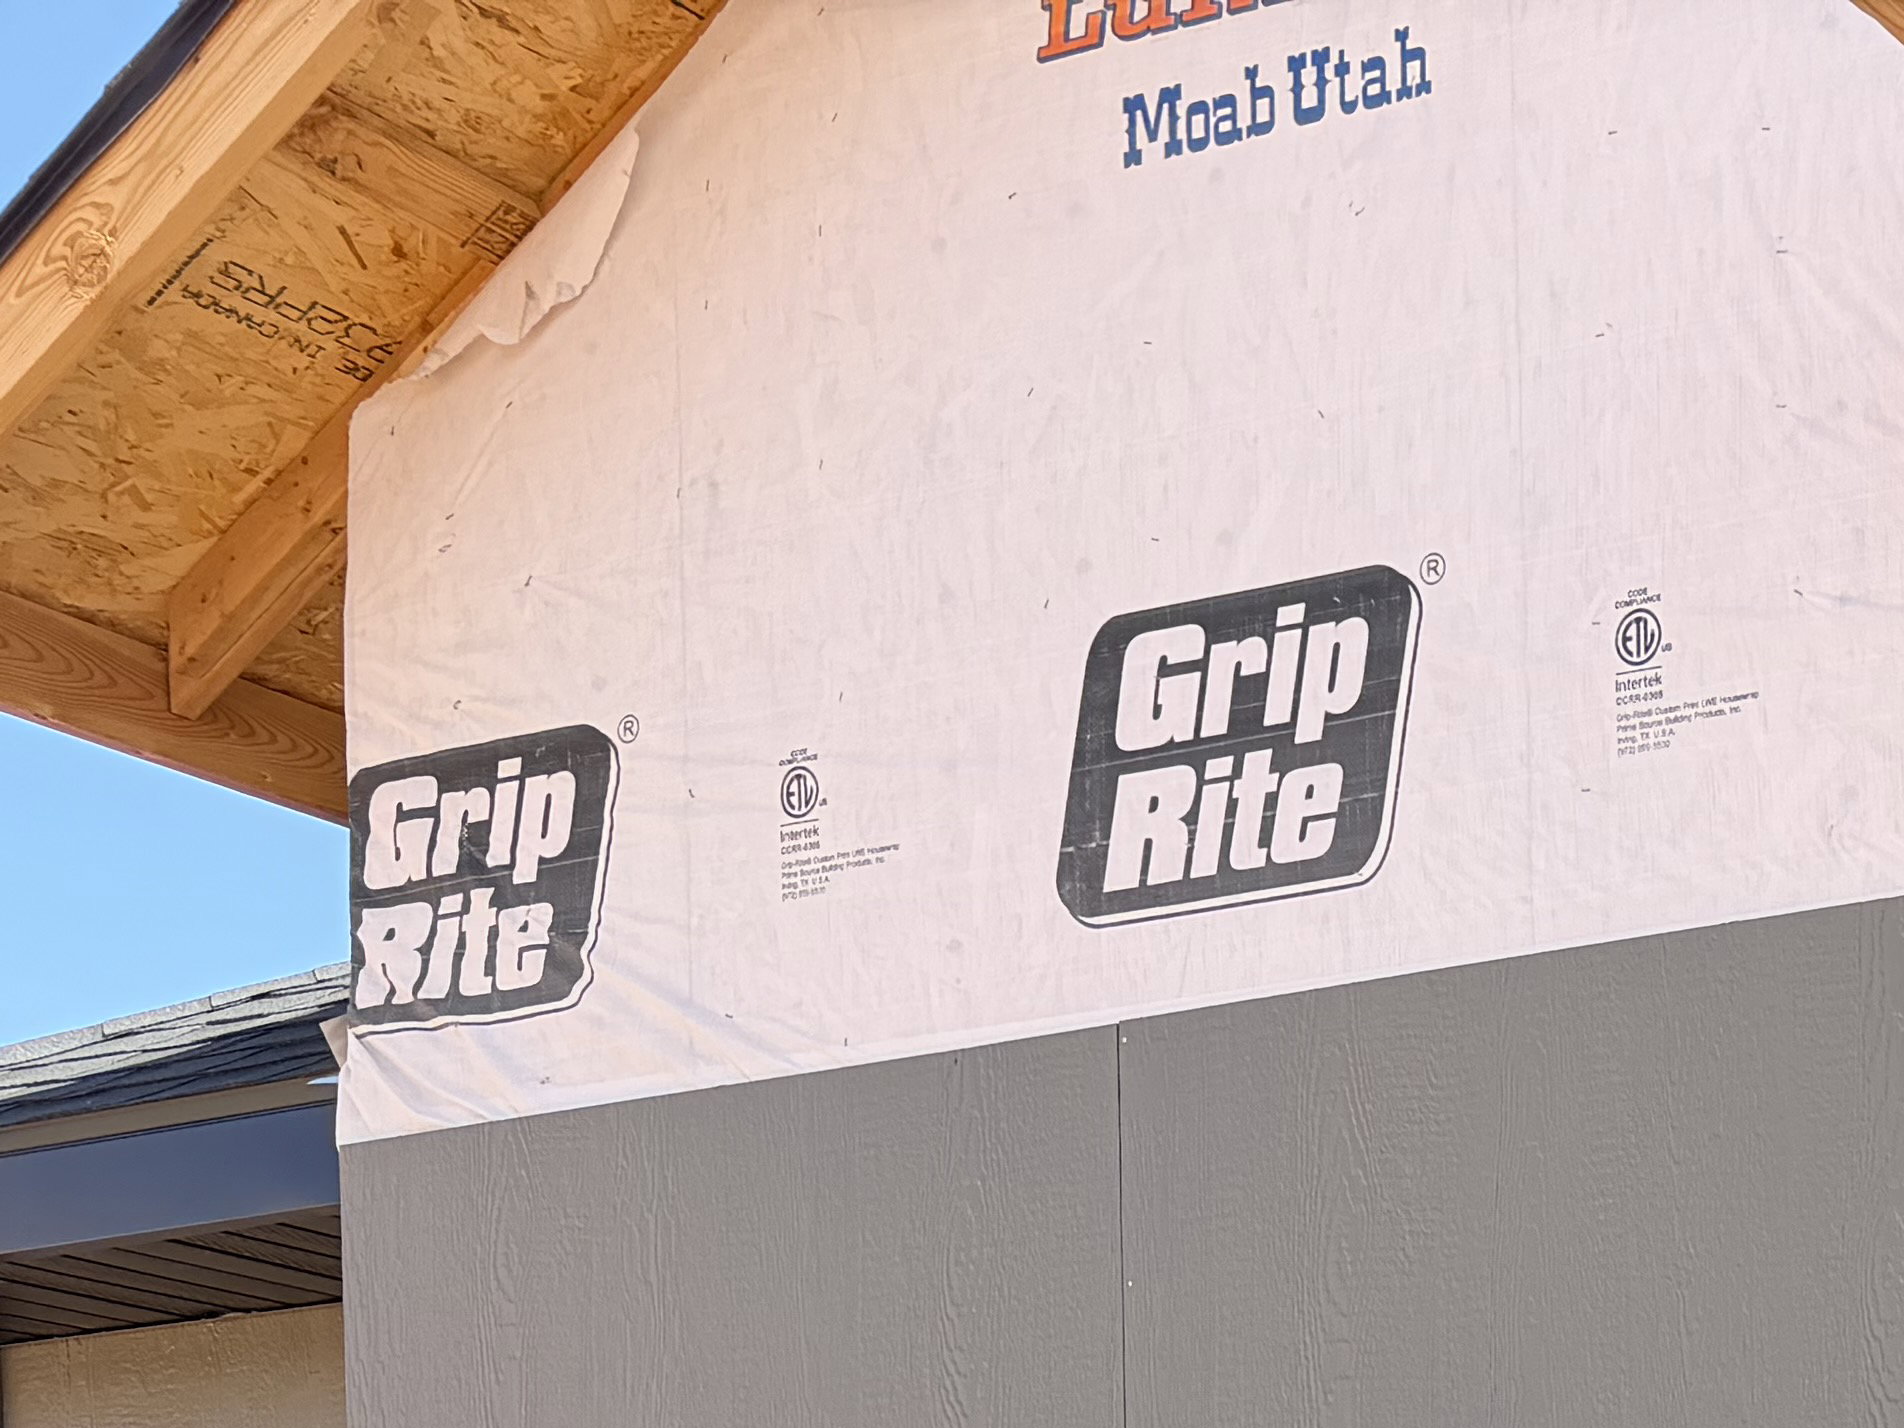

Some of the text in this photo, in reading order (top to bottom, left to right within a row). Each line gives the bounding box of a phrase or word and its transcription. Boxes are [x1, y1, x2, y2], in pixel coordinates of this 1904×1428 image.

[1122, 63, 1275, 169] Moab
[1286, 26, 1433, 126] Utah
[180, 284, 281, 340] CANADA
[1115, 602, 1369, 752] Grip
[1615, 672, 1662, 692] Intertek
[363, 756, 576, 890] Grip
[1103, 748, 1344, 893] Rite
[355, 887, 553, 1009] Rite
